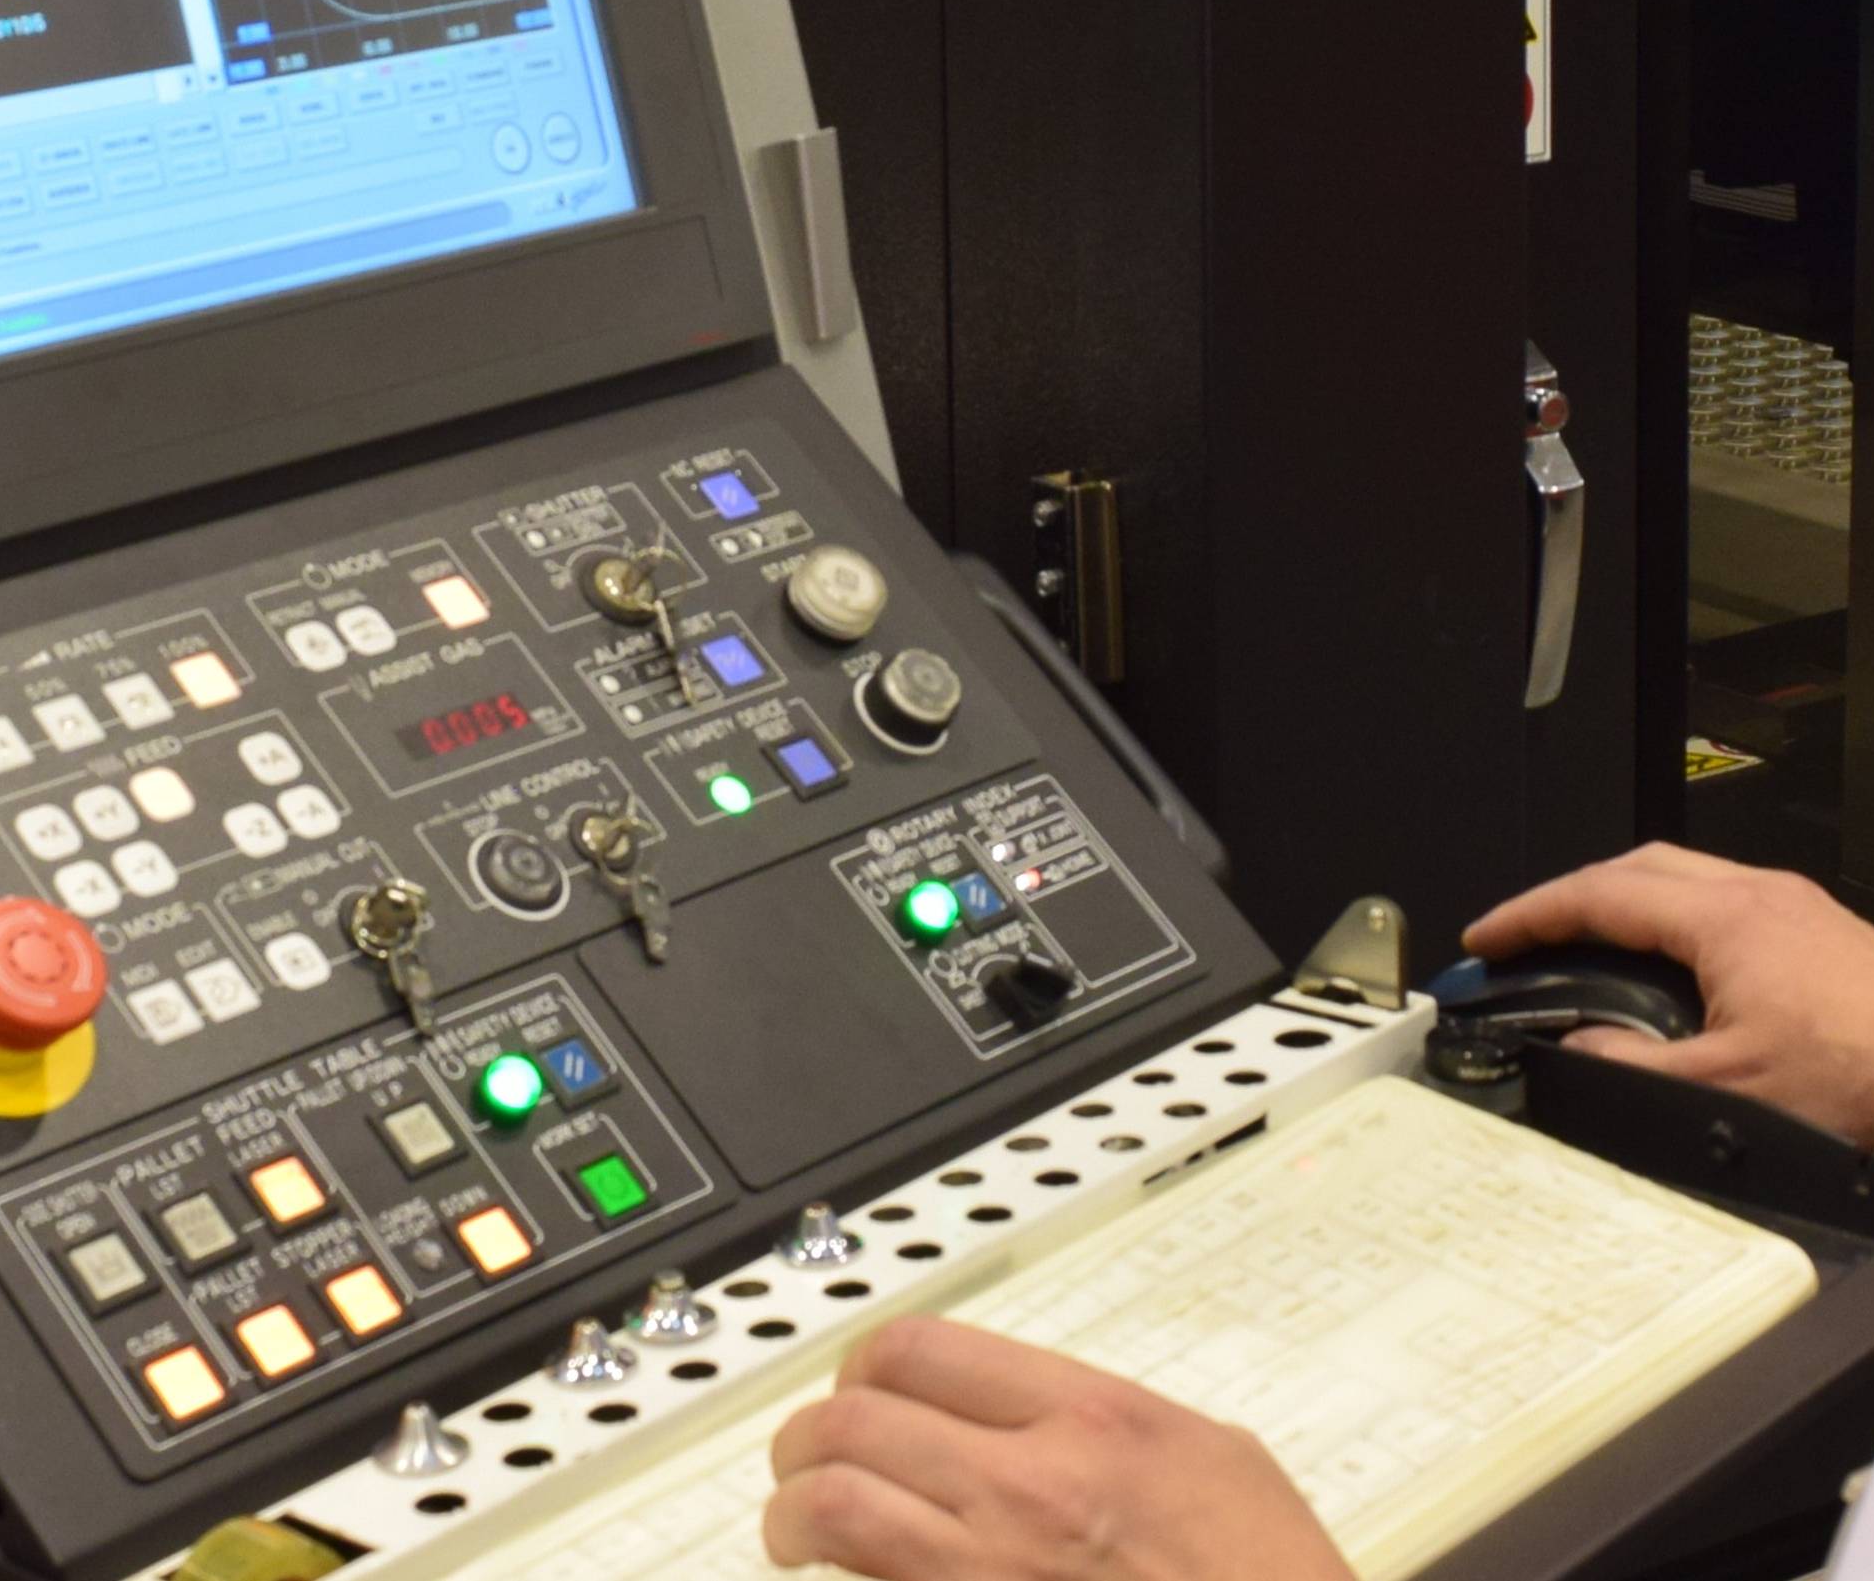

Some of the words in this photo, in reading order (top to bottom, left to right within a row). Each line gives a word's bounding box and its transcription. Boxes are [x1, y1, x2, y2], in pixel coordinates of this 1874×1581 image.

[328, 548, 390, 580] MODE
[52, 628, 114, 661] RATE
[368, 650, 435, 690] ASSIST
[439, 636, 486, 666] GAS
[124, 734, 184, 768] FEED
[520, 757, 601, 798] CONTROL
[888, 805, 959, 844] ROTARY
[121, 900, 193, 940] MODE
[201, 1069, 305, 1124] SHUTTLE
[308, 1037, 383, 1077] TABLE
[114, 1134, 205, 1187] PALLET
[214, 1106, 278, 1145] FEED
[227, 1131, 286, 1169] LASER
[148, 1172, 182, 1202] LST
[190, 1256, 264, 1303] PALLET
[270, 1218, 353, 1270] STOPPER
